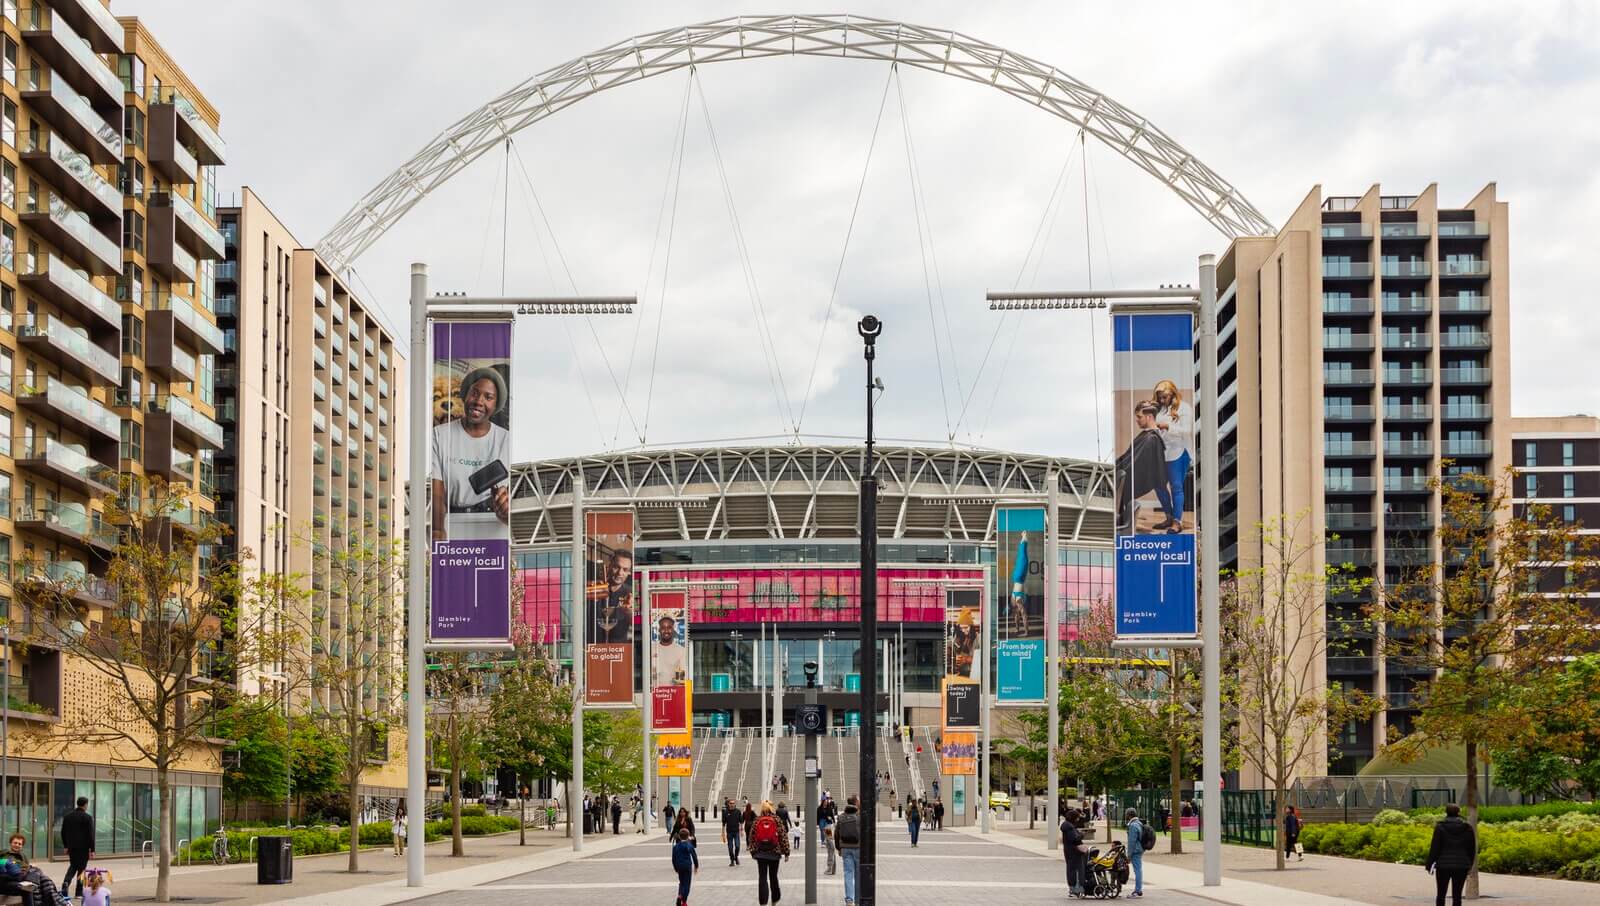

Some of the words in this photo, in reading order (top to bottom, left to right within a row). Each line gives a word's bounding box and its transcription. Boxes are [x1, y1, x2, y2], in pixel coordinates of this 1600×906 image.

[439, 545, 487, 555] Discover
[1123, 540, 1173, 550] Discover
[1123, 553, 1131, 561] a
[1134, 553, 1158, 561] new
[1160, 550, 1187, 561] local
[439, 558, 446, 566] a
[449, 558, 472, 566] new
[474, 556, 500, 566] local
[609, 645, 625, 653] local
[1020, 643, 1038, 651] body
[600, 653, 621, 661] global
